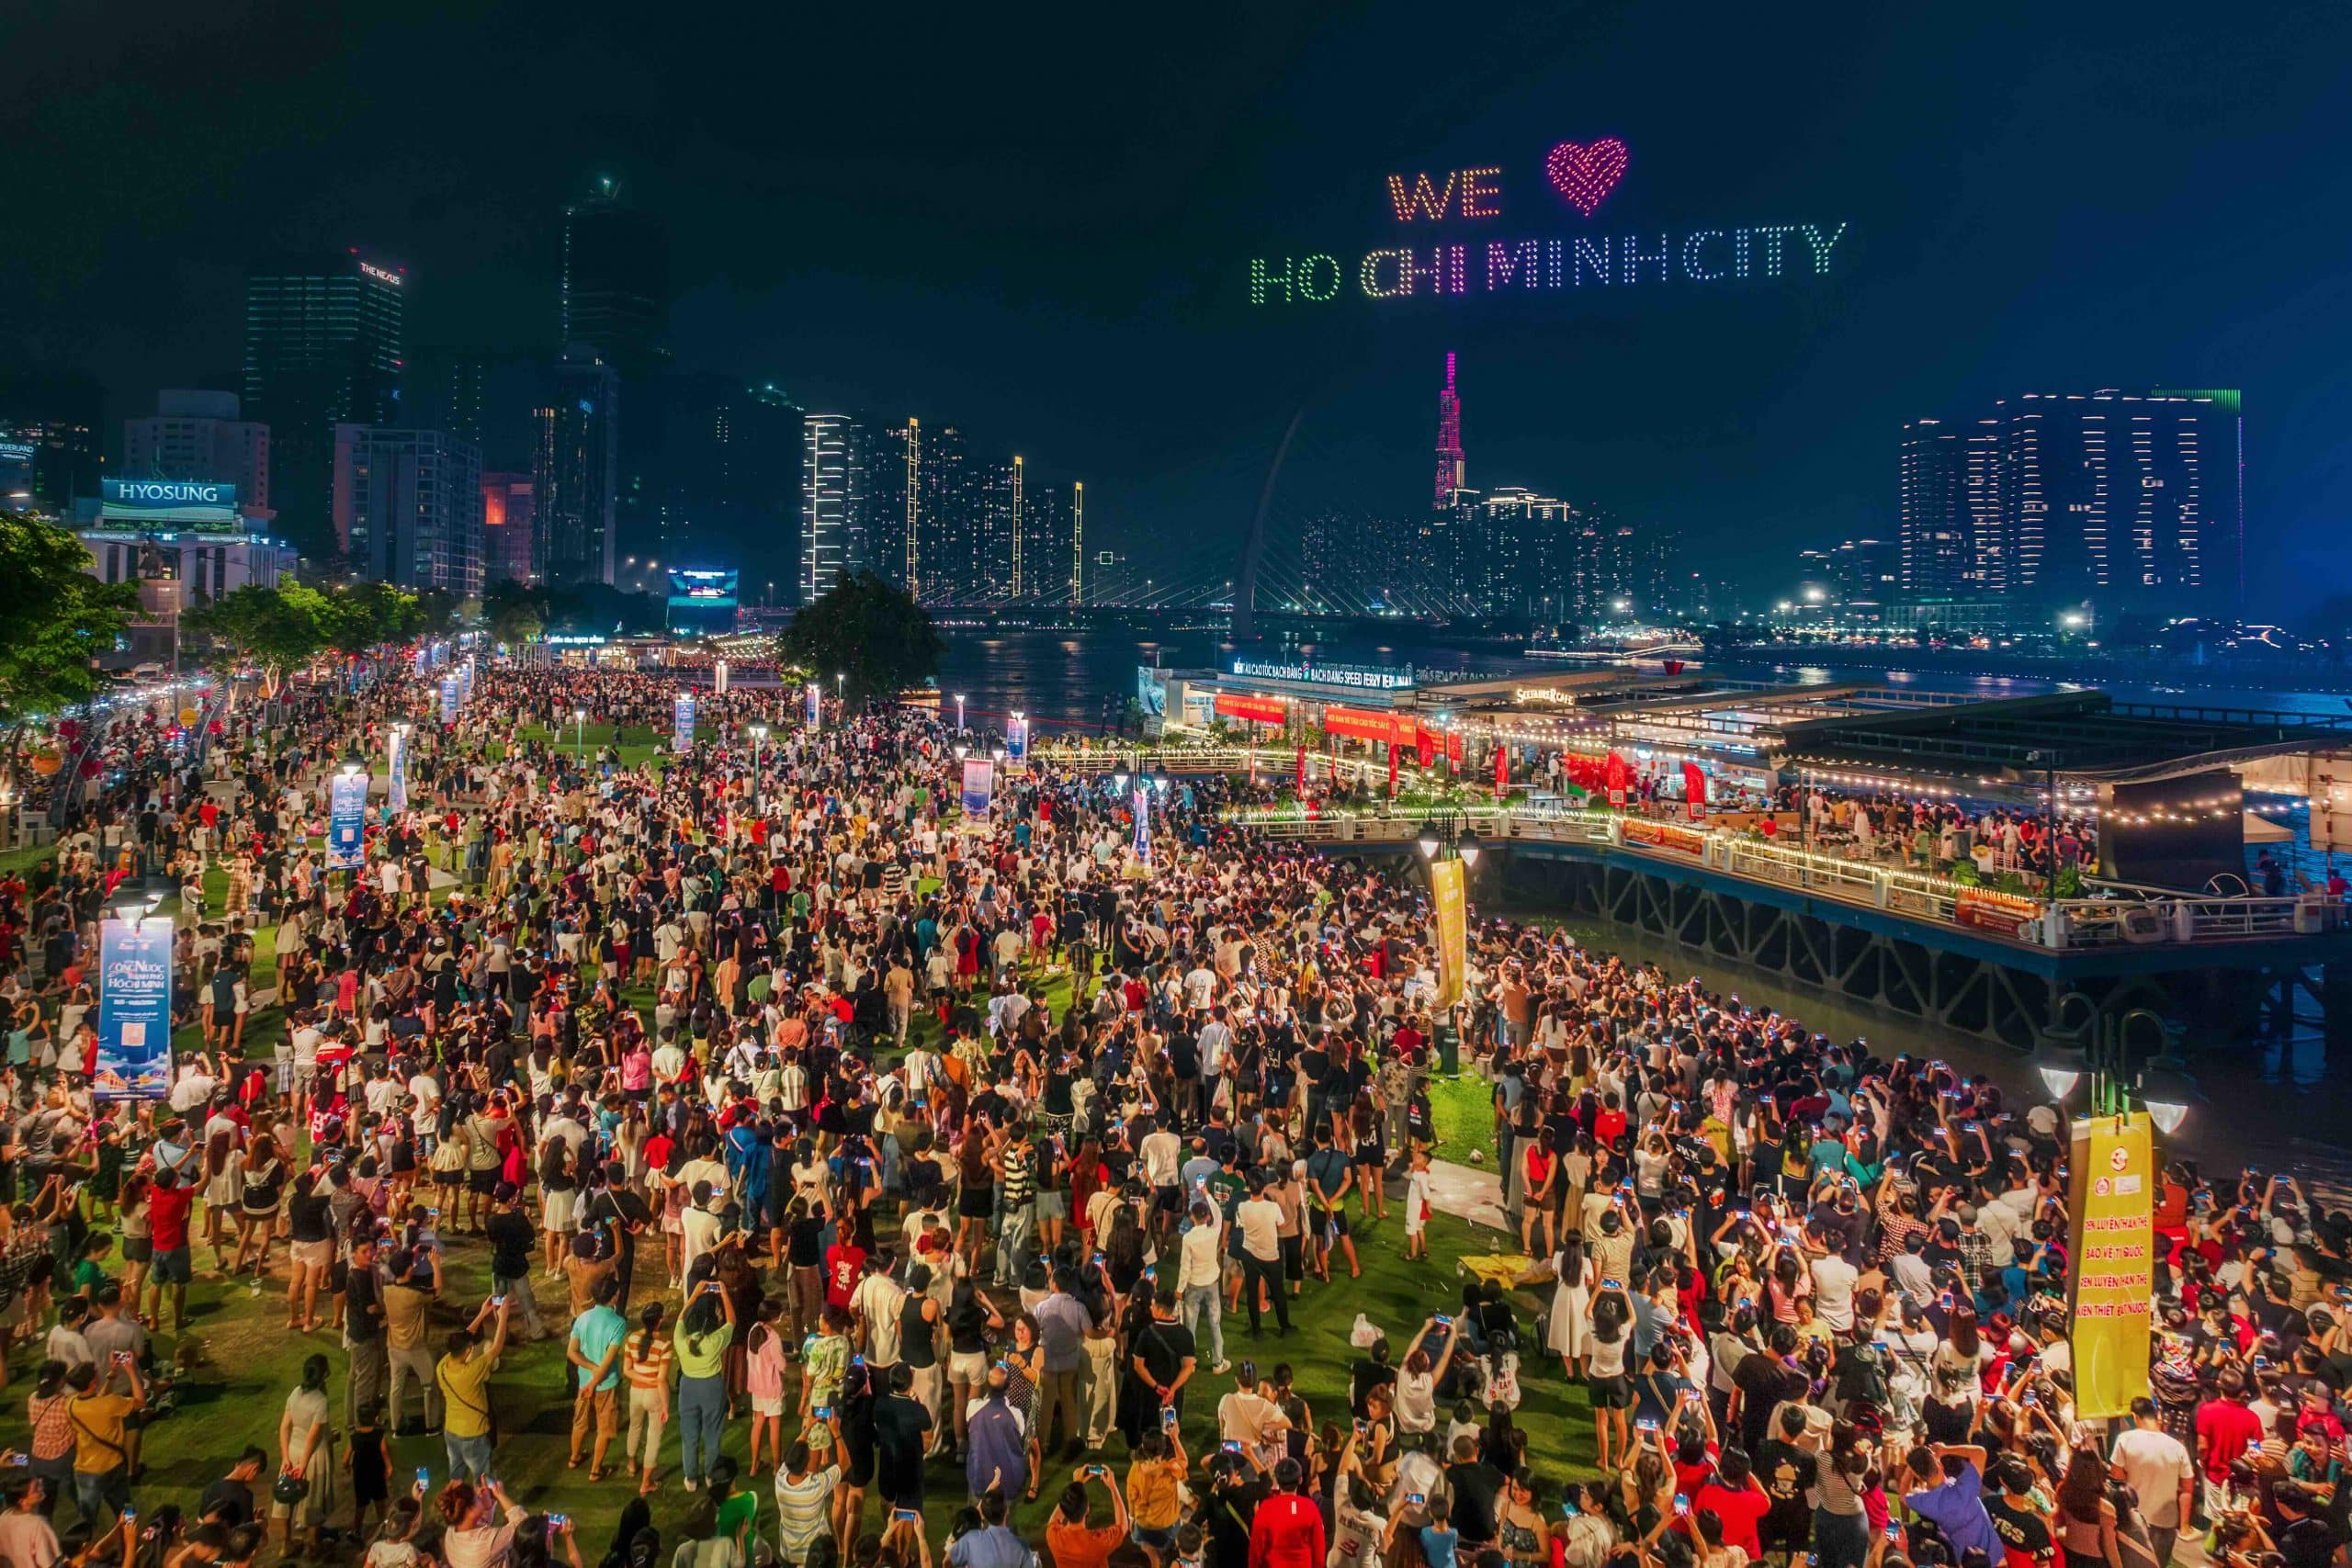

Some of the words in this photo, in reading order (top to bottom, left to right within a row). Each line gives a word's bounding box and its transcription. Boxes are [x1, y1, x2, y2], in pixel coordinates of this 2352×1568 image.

[1388, 168, 1500, 220] WE
[360, 262, 377, 276] THE
[1251, 254, 1340, 304] HO
[1361, 245, 1465, 297] CHI
[1488, 233, 1667, 291] MINH
[1682, 222, 1847, 280] CITY
[119, 483, 218, 502] HYOSUNG
[1311, 669, 1327, 682] BACH
[1328, 670, 1344, 683] DANG
[1344, 671, 1363, 685] SPEED
[1363, 672, 1382, 687] FERRY
